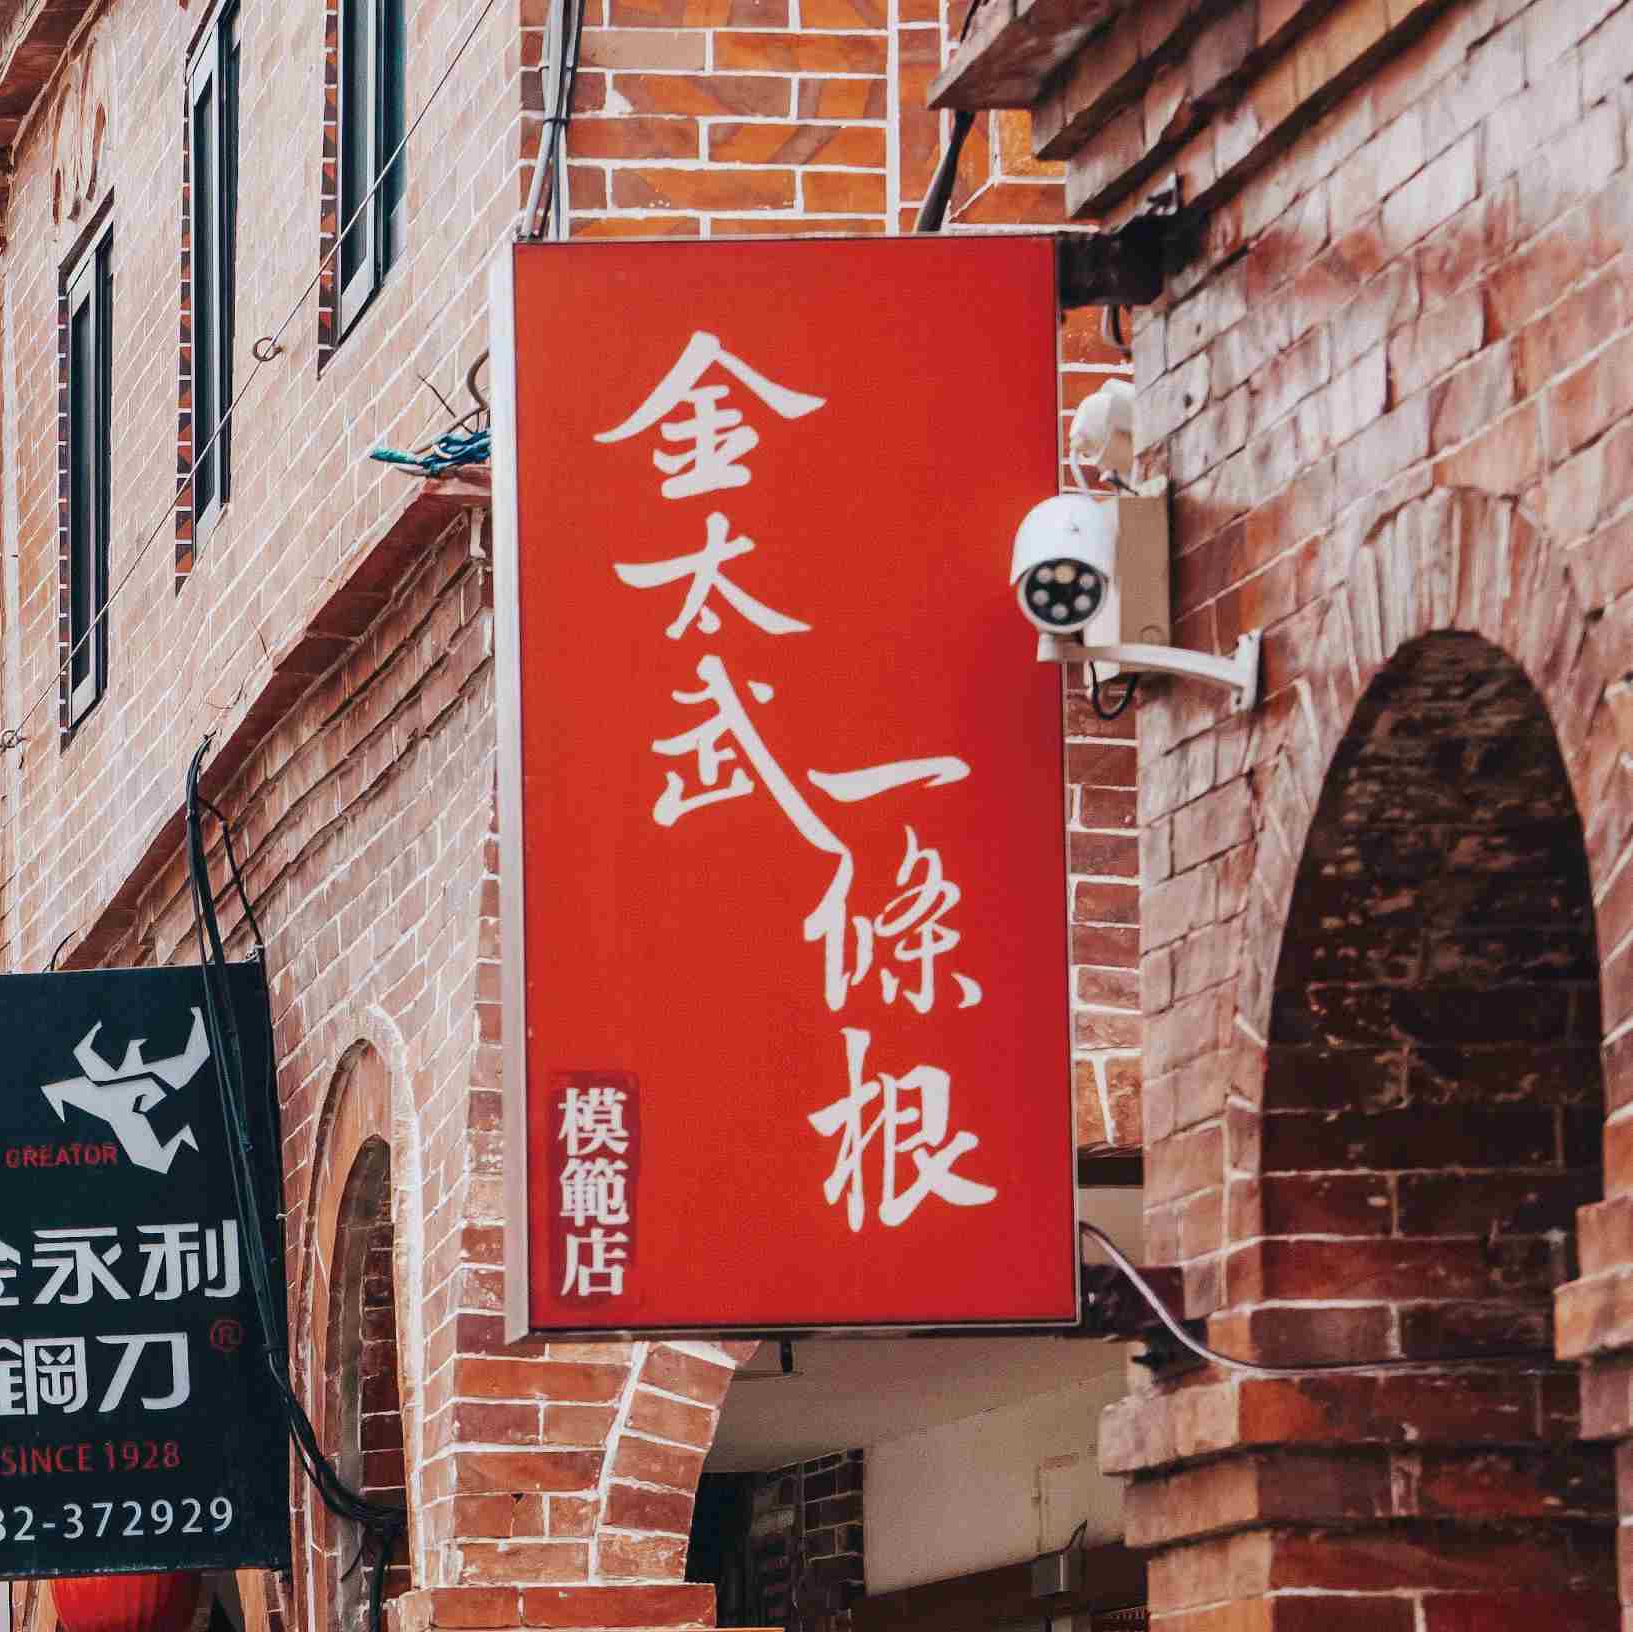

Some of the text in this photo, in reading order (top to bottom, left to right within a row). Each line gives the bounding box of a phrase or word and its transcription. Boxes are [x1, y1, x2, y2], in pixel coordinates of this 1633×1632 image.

[594, 331, 847, 854] 金太武
[802, 755, 997, 1234] 一條根
[557, 1086, 630, 1298] 模範店
[0, 1441, 182, 1476] SINCE 1928
